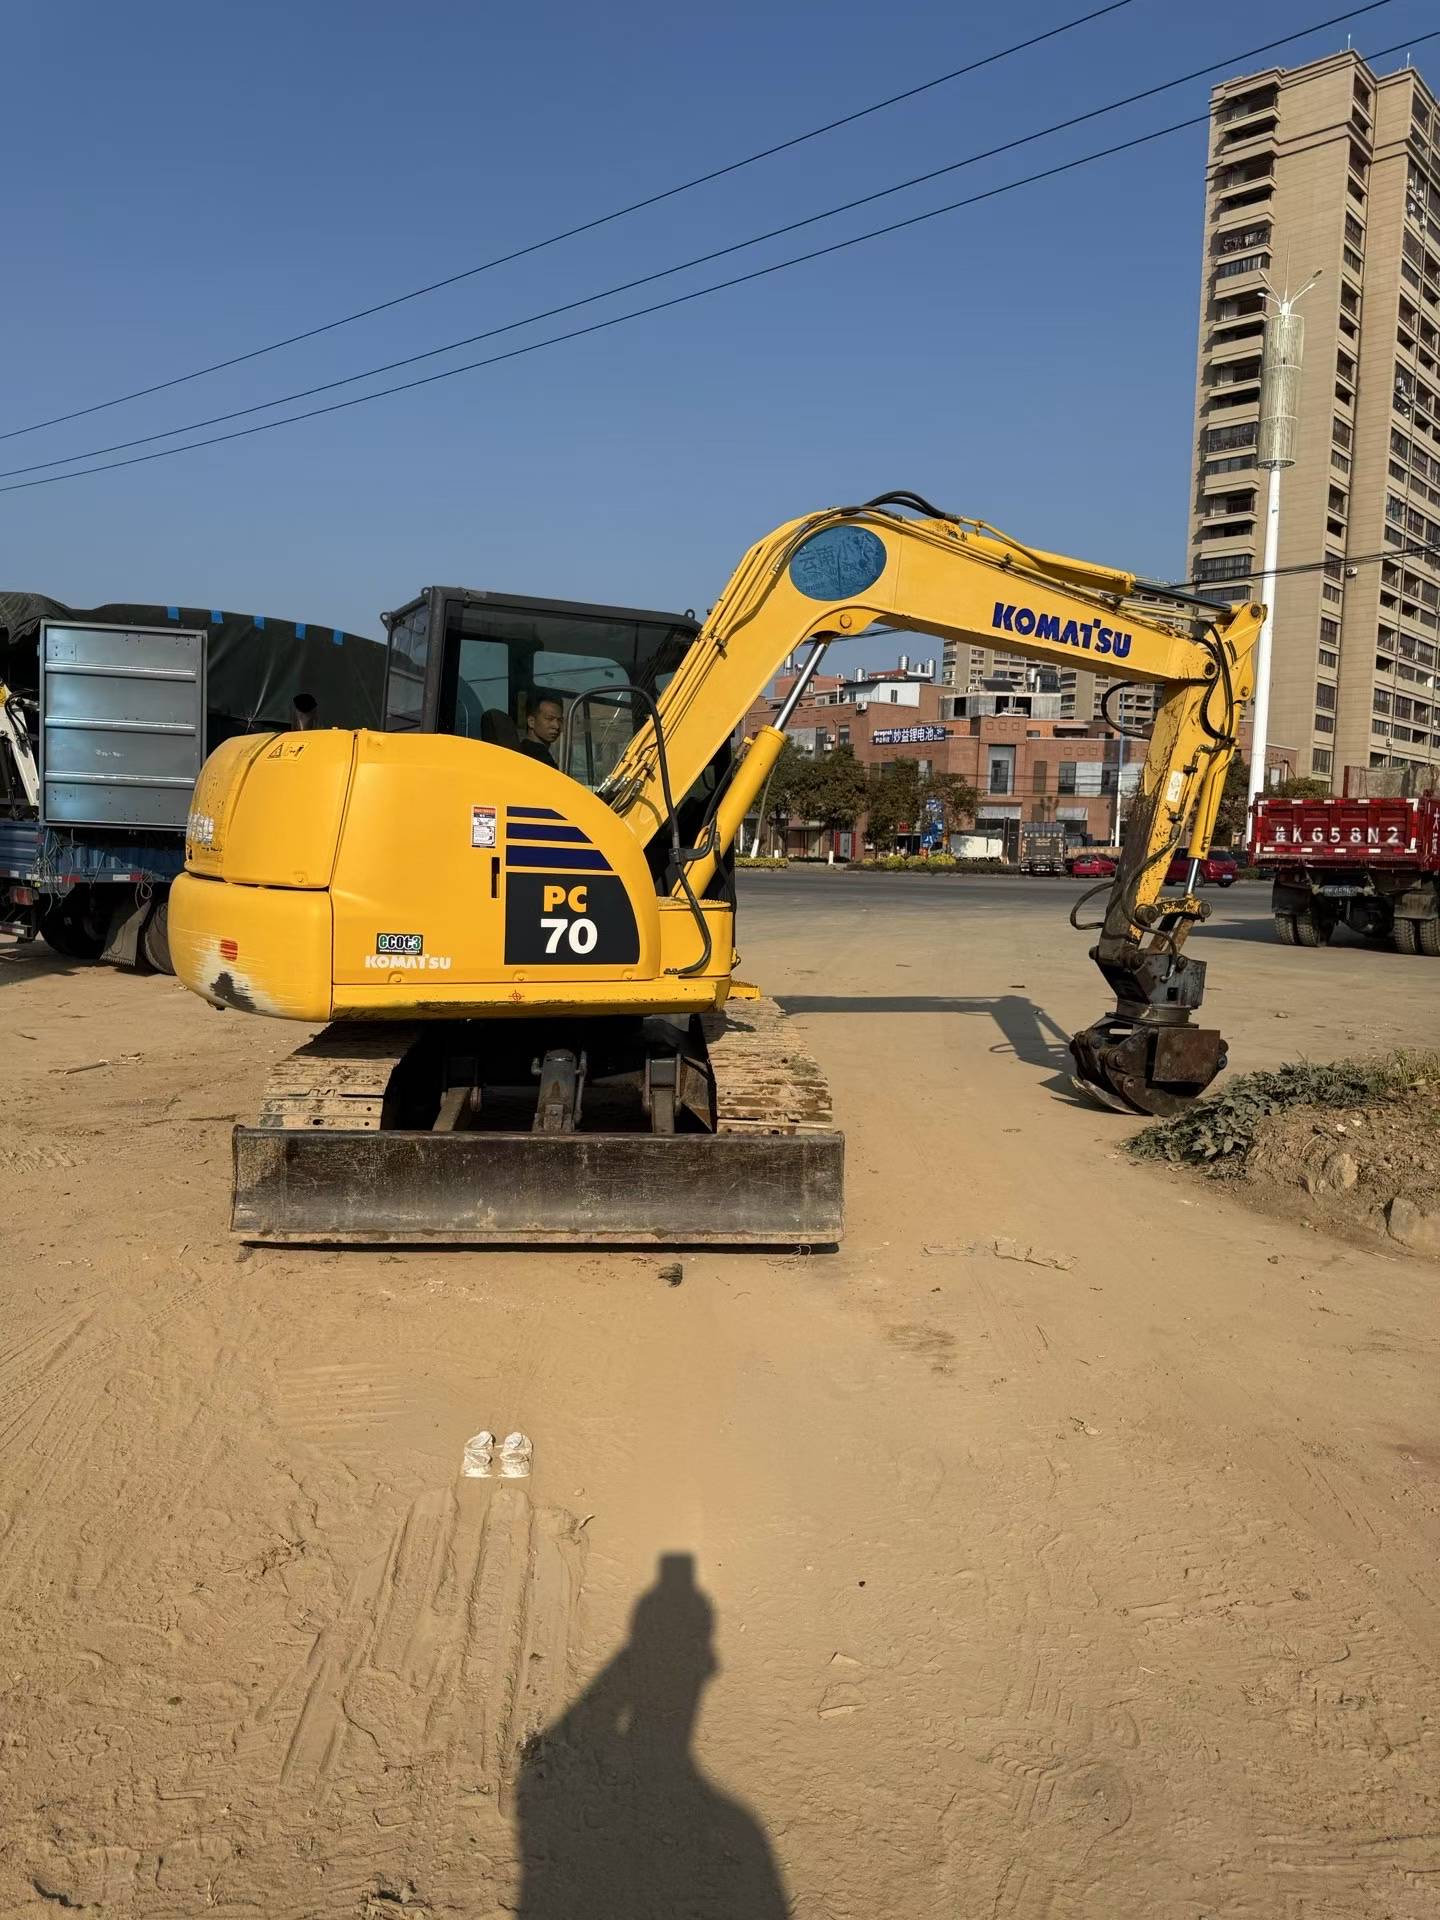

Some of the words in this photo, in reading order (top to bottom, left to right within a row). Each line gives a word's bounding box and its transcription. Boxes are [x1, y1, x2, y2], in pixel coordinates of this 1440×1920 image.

[992, 602, 1132, 658] KOMATSU
[543, 885, 588, 913] PC
[540, 918, 598, 954] 70
[365, 954, 451, 970] KOMATSU
